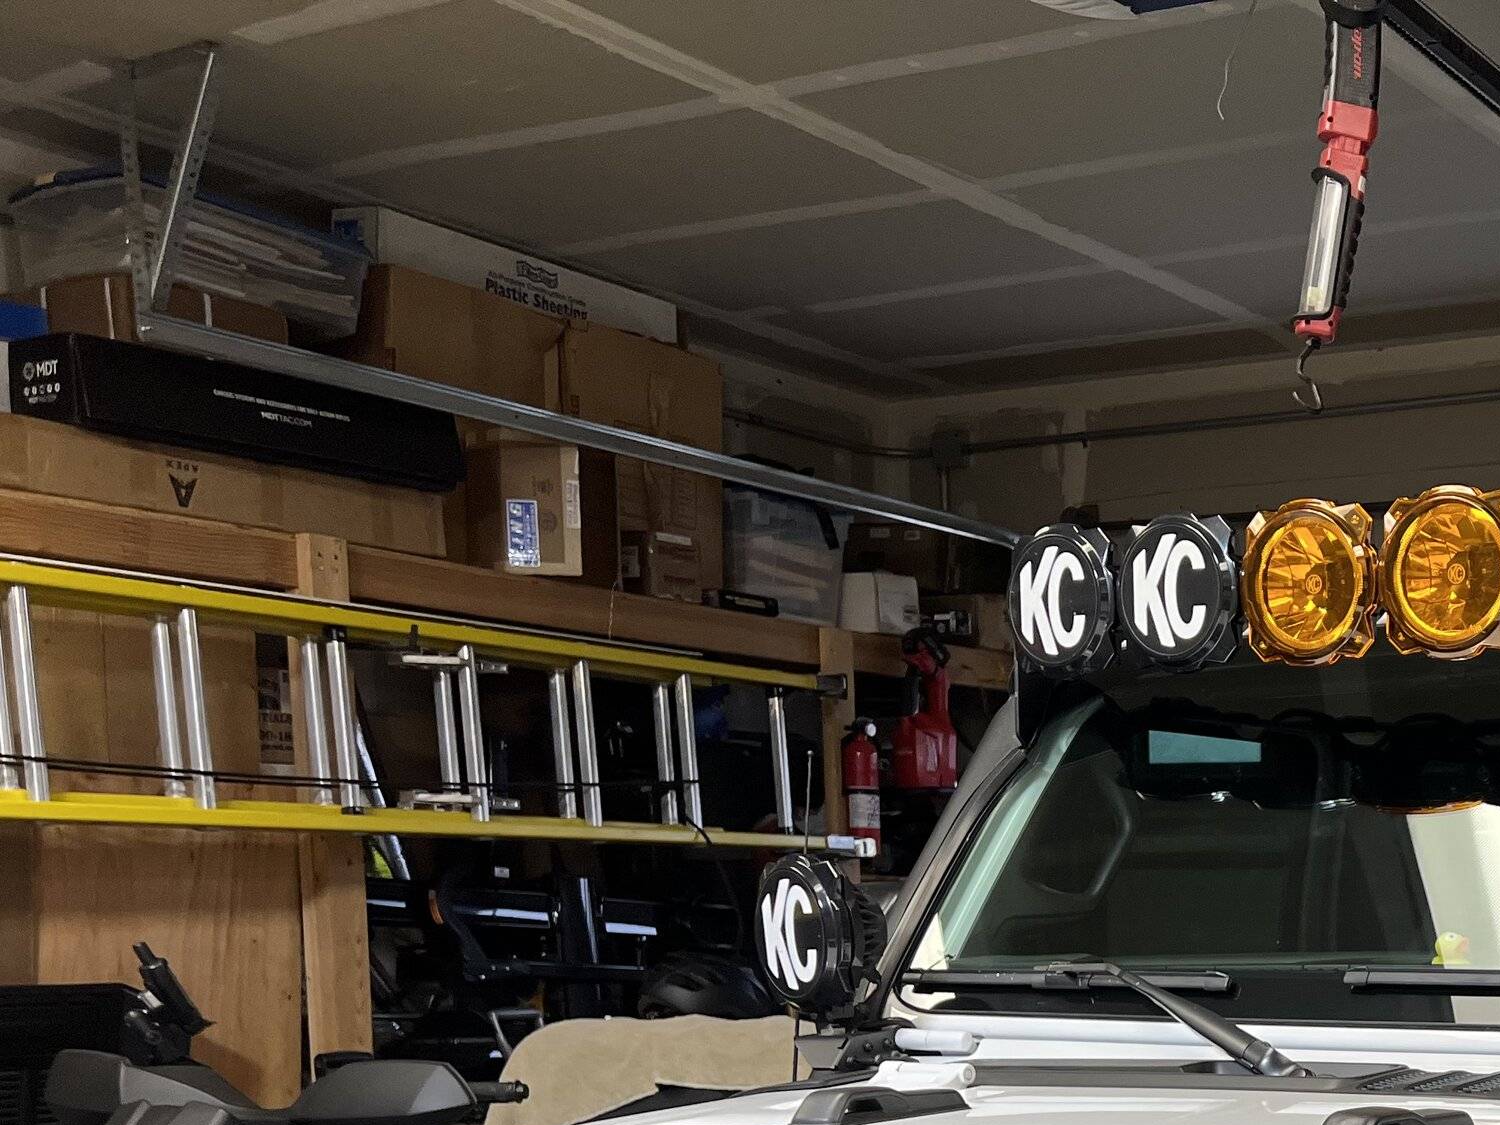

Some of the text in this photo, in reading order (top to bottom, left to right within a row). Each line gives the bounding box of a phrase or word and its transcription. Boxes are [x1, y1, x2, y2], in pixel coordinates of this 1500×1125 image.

[485, 277, 529, 306] Plastic
[36, 359, 59, 378] MDT
[1306, 576, 1321, 593] KC
[1449, 564, 1464, 583] KC
[1020, 546, 1086, 656] KC
[1133, 534, 1207, 648] KC
[762, 879, 818, 991] KC
